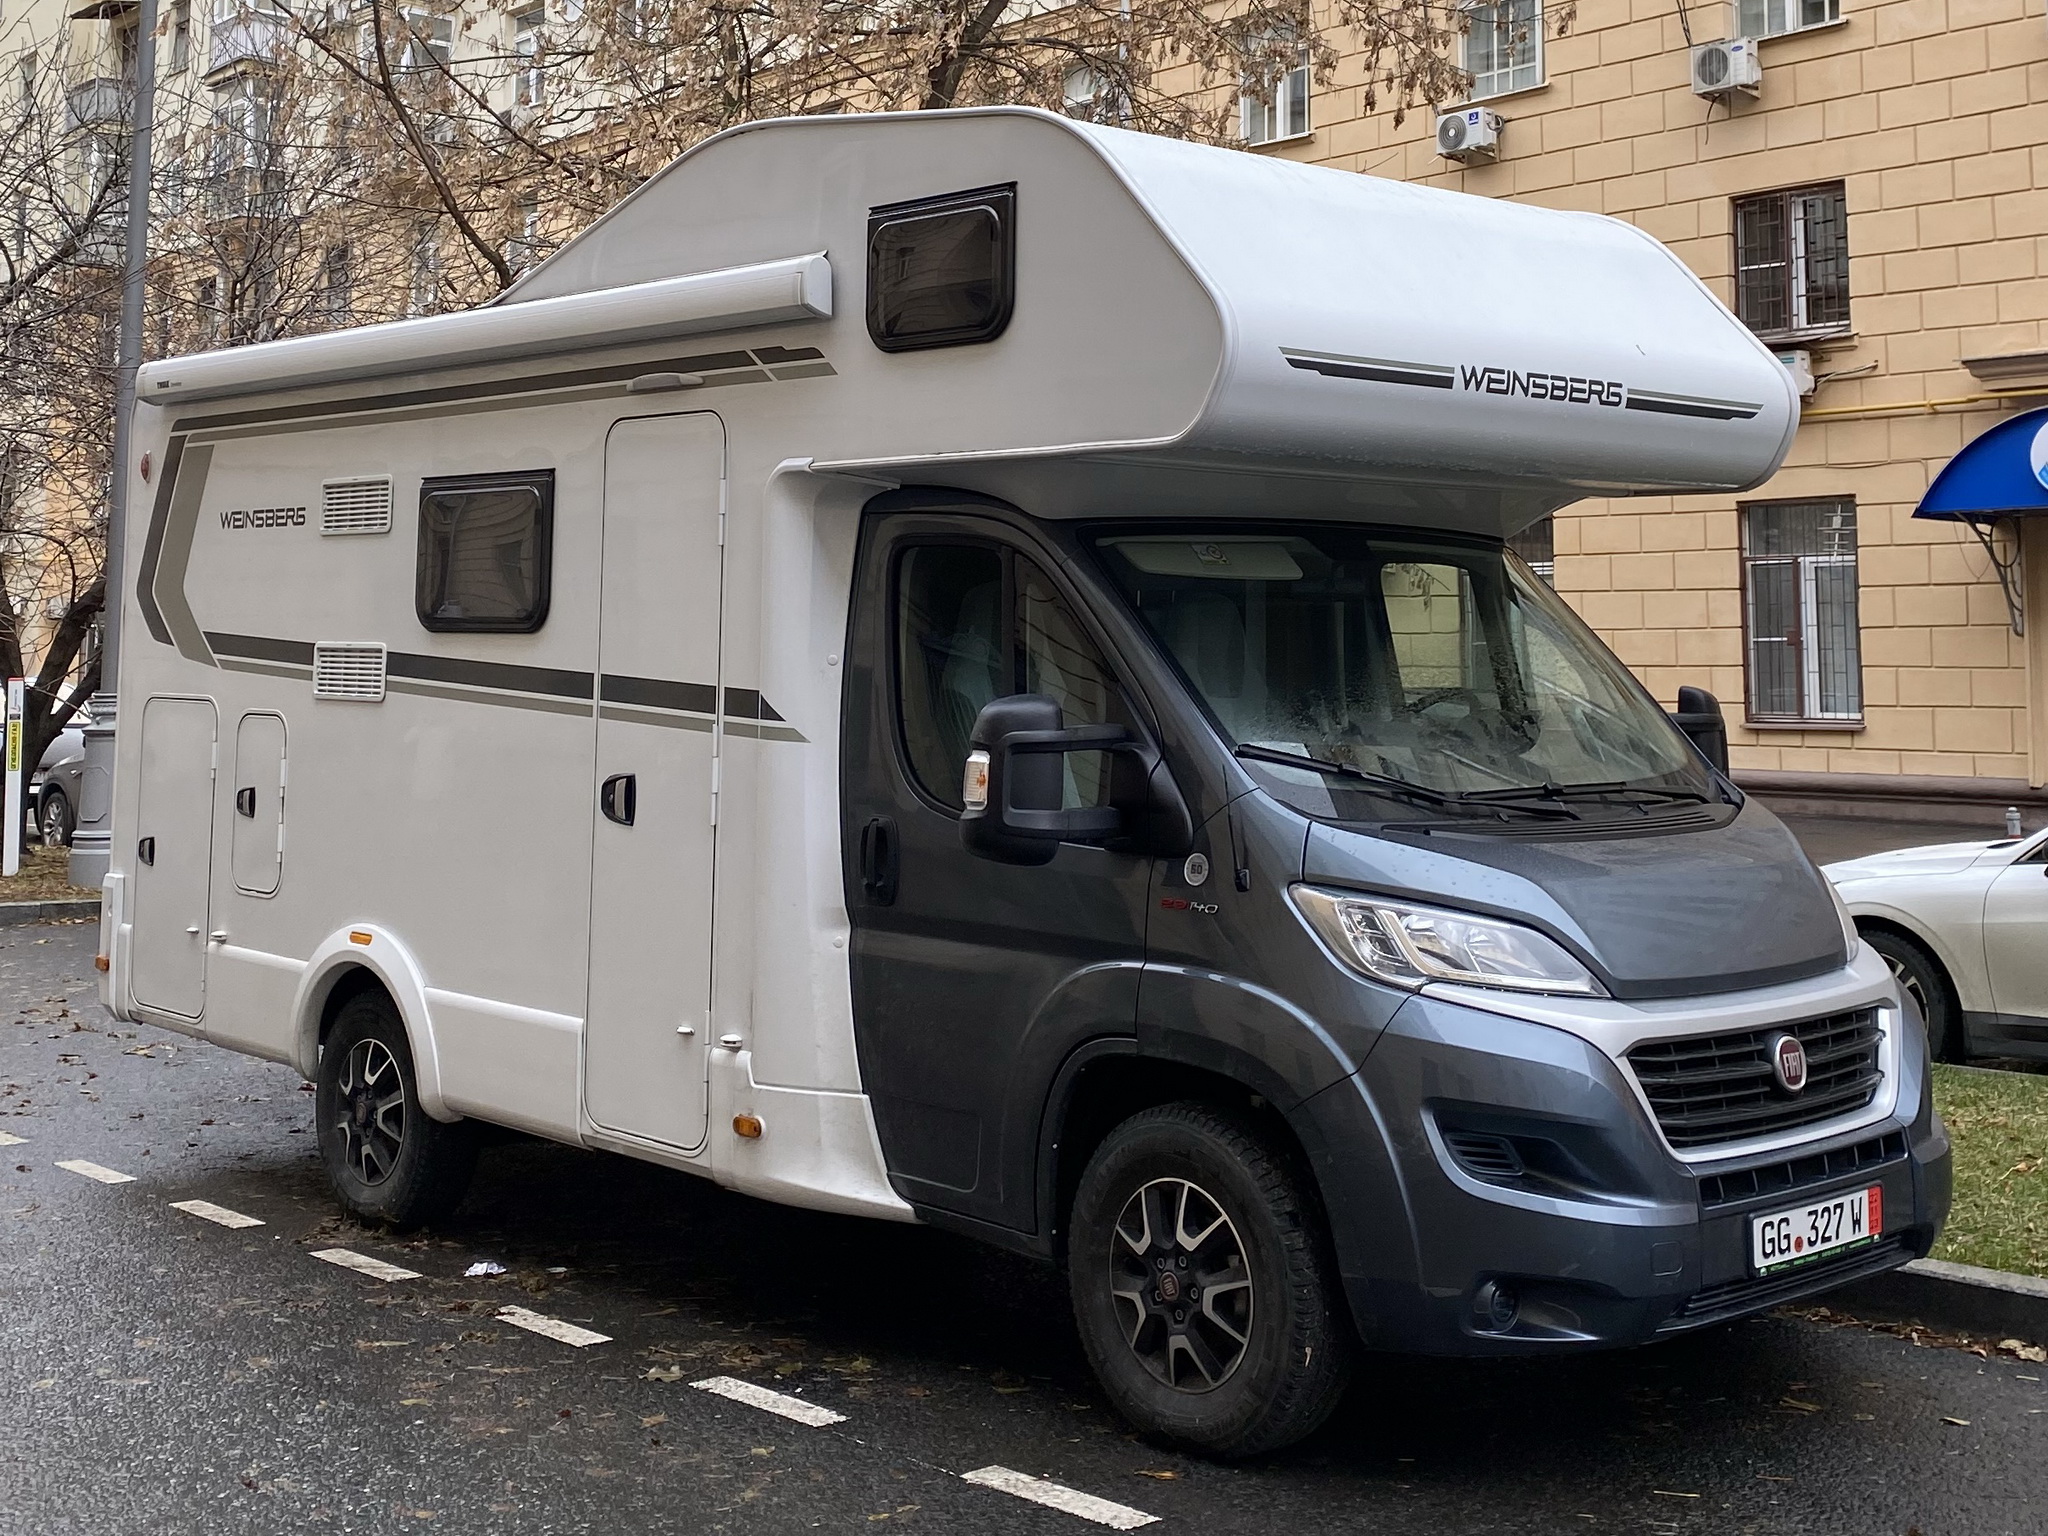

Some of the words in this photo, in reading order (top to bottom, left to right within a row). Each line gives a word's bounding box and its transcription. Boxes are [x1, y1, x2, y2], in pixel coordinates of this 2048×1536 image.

[1460, 364, 1623, 407] WEINSBERG
[220, 507, 306, 529] WEINSBERG
[1189, 901, 1219, 914] 140
[1782, 1051, 1802, 1078] FIAT
[1761, 1216, 1791, 1259] GG
[1807, 1202, 1844, 1248] 327
[1850, 1195, 1863, 1236] W
